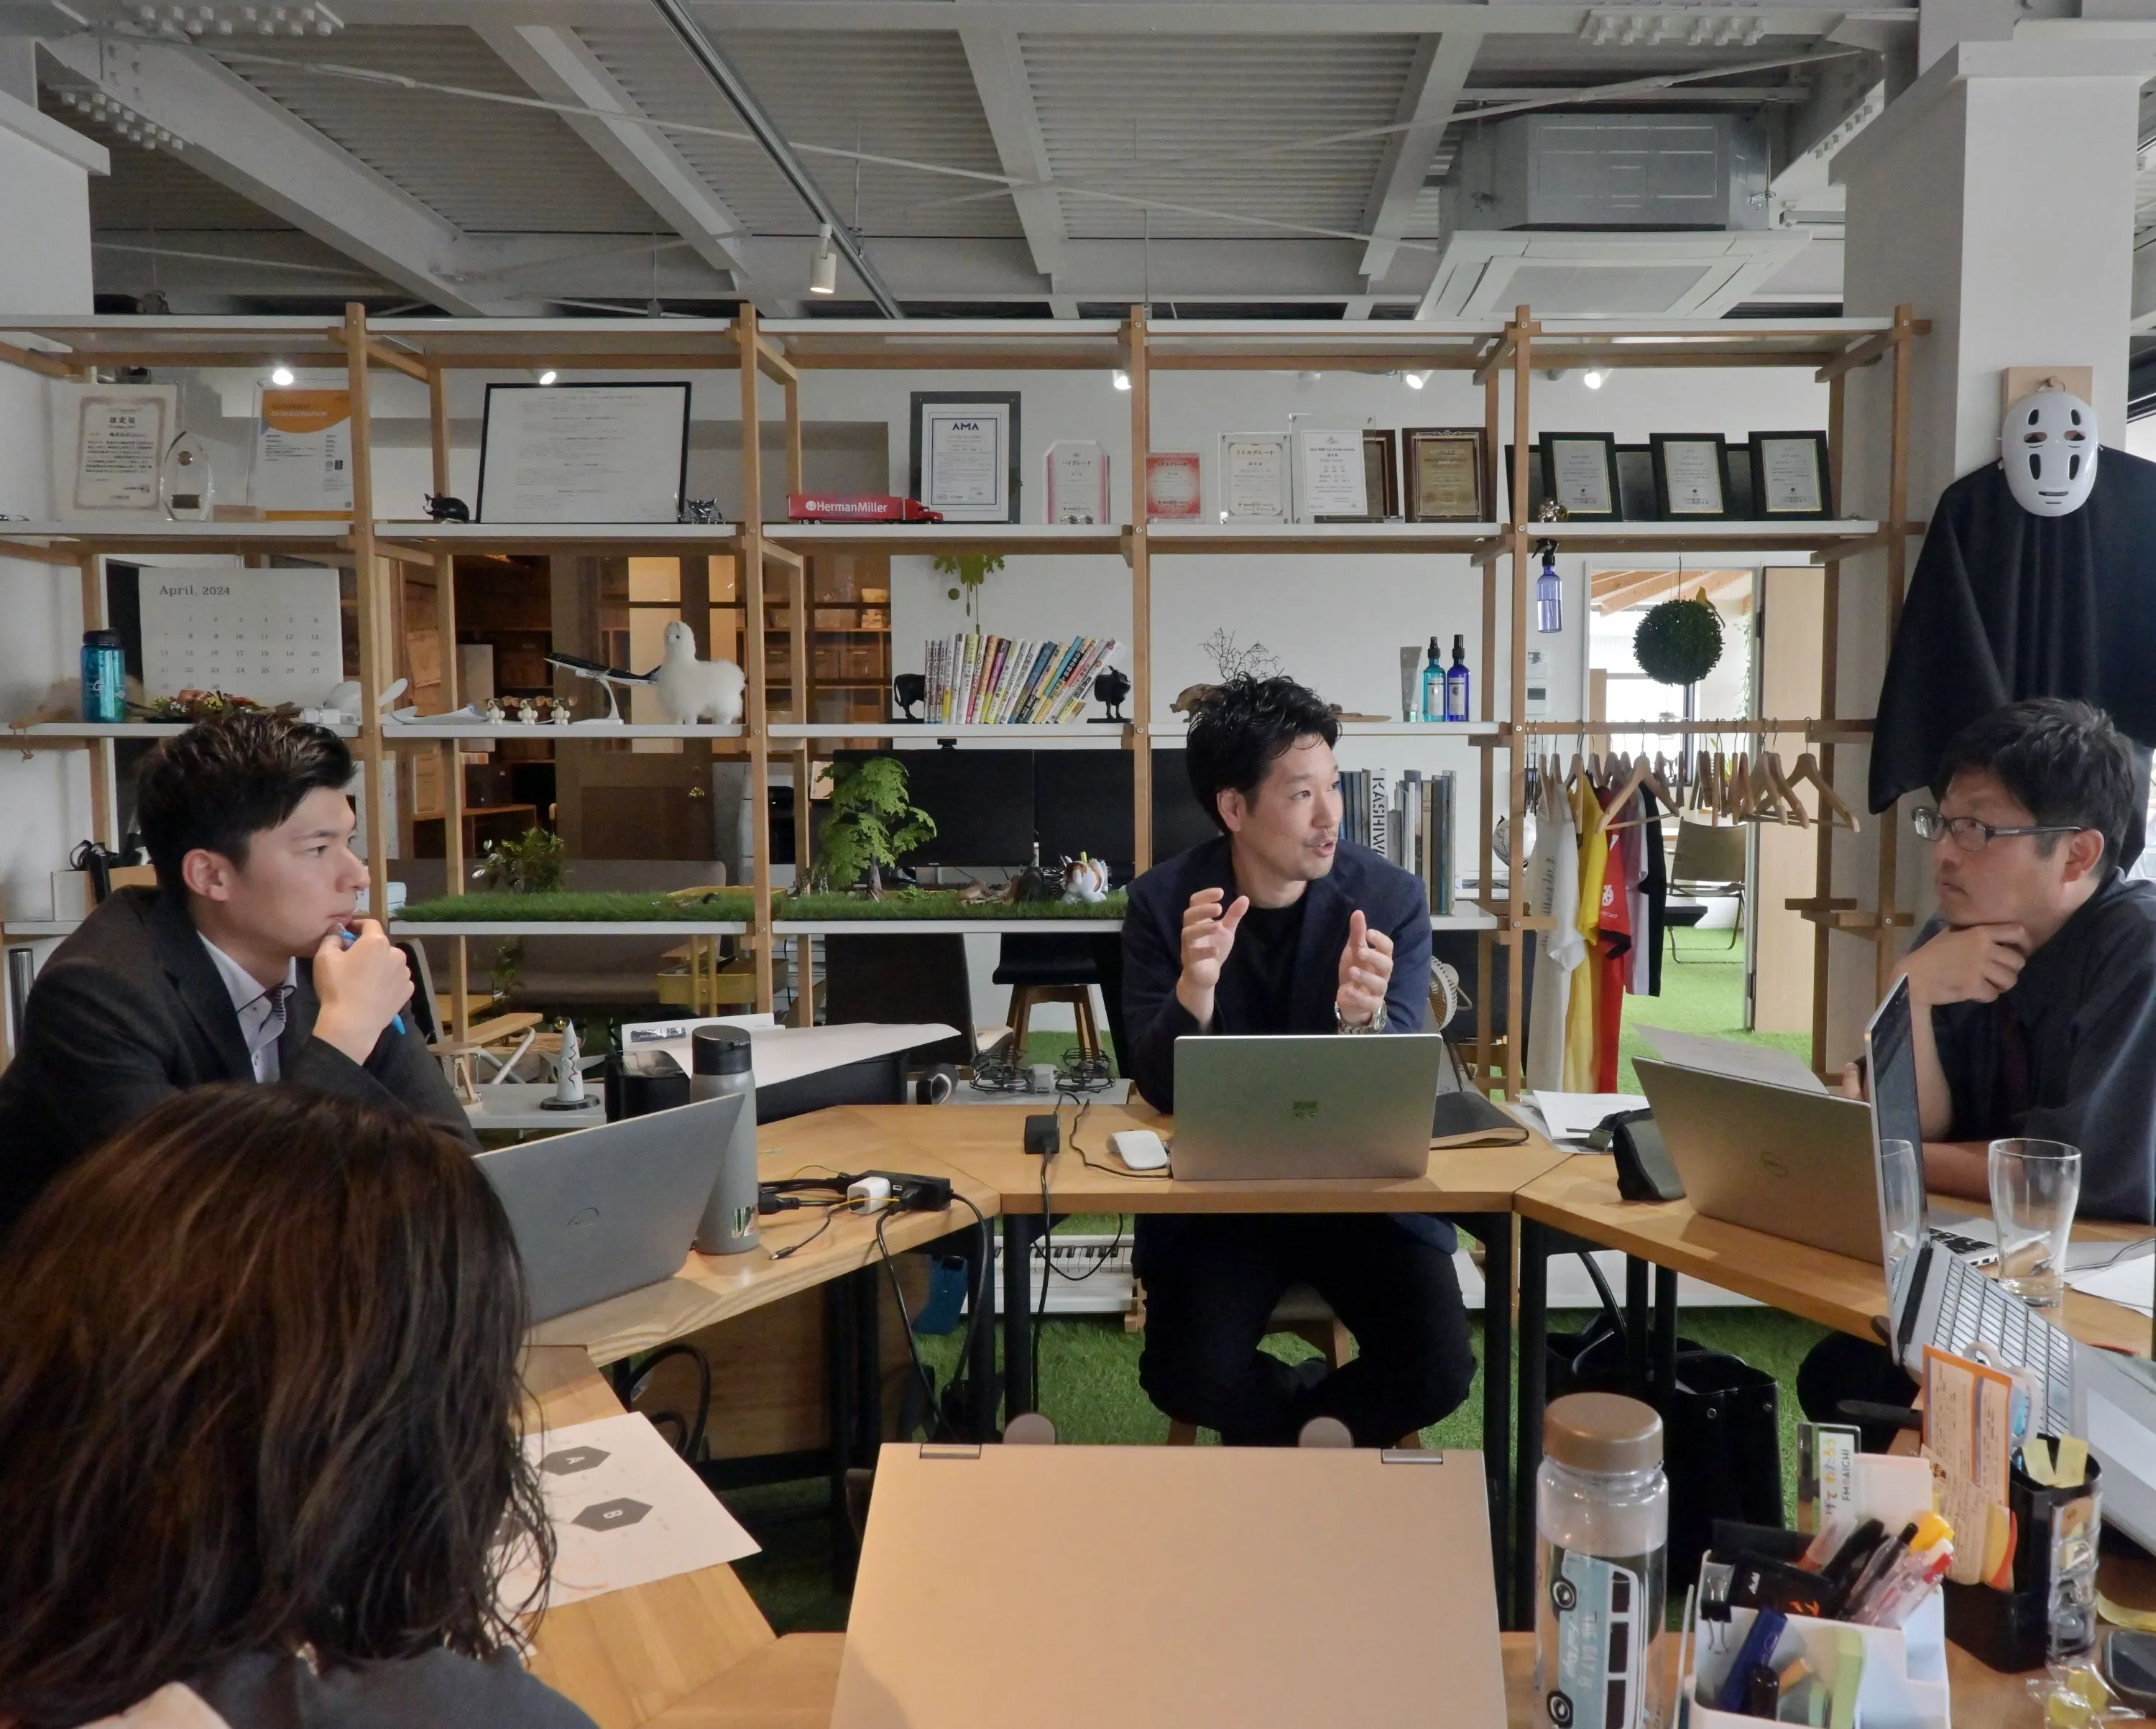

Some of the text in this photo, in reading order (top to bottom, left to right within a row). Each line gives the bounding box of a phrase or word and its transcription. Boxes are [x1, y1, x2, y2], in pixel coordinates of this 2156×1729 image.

[952, 422, 979, 430] AMA
[816, 501, 888, 512] HermanMiller
[202, 586, 230, 596] 2024
[602, 1509, 624, 1519] B
